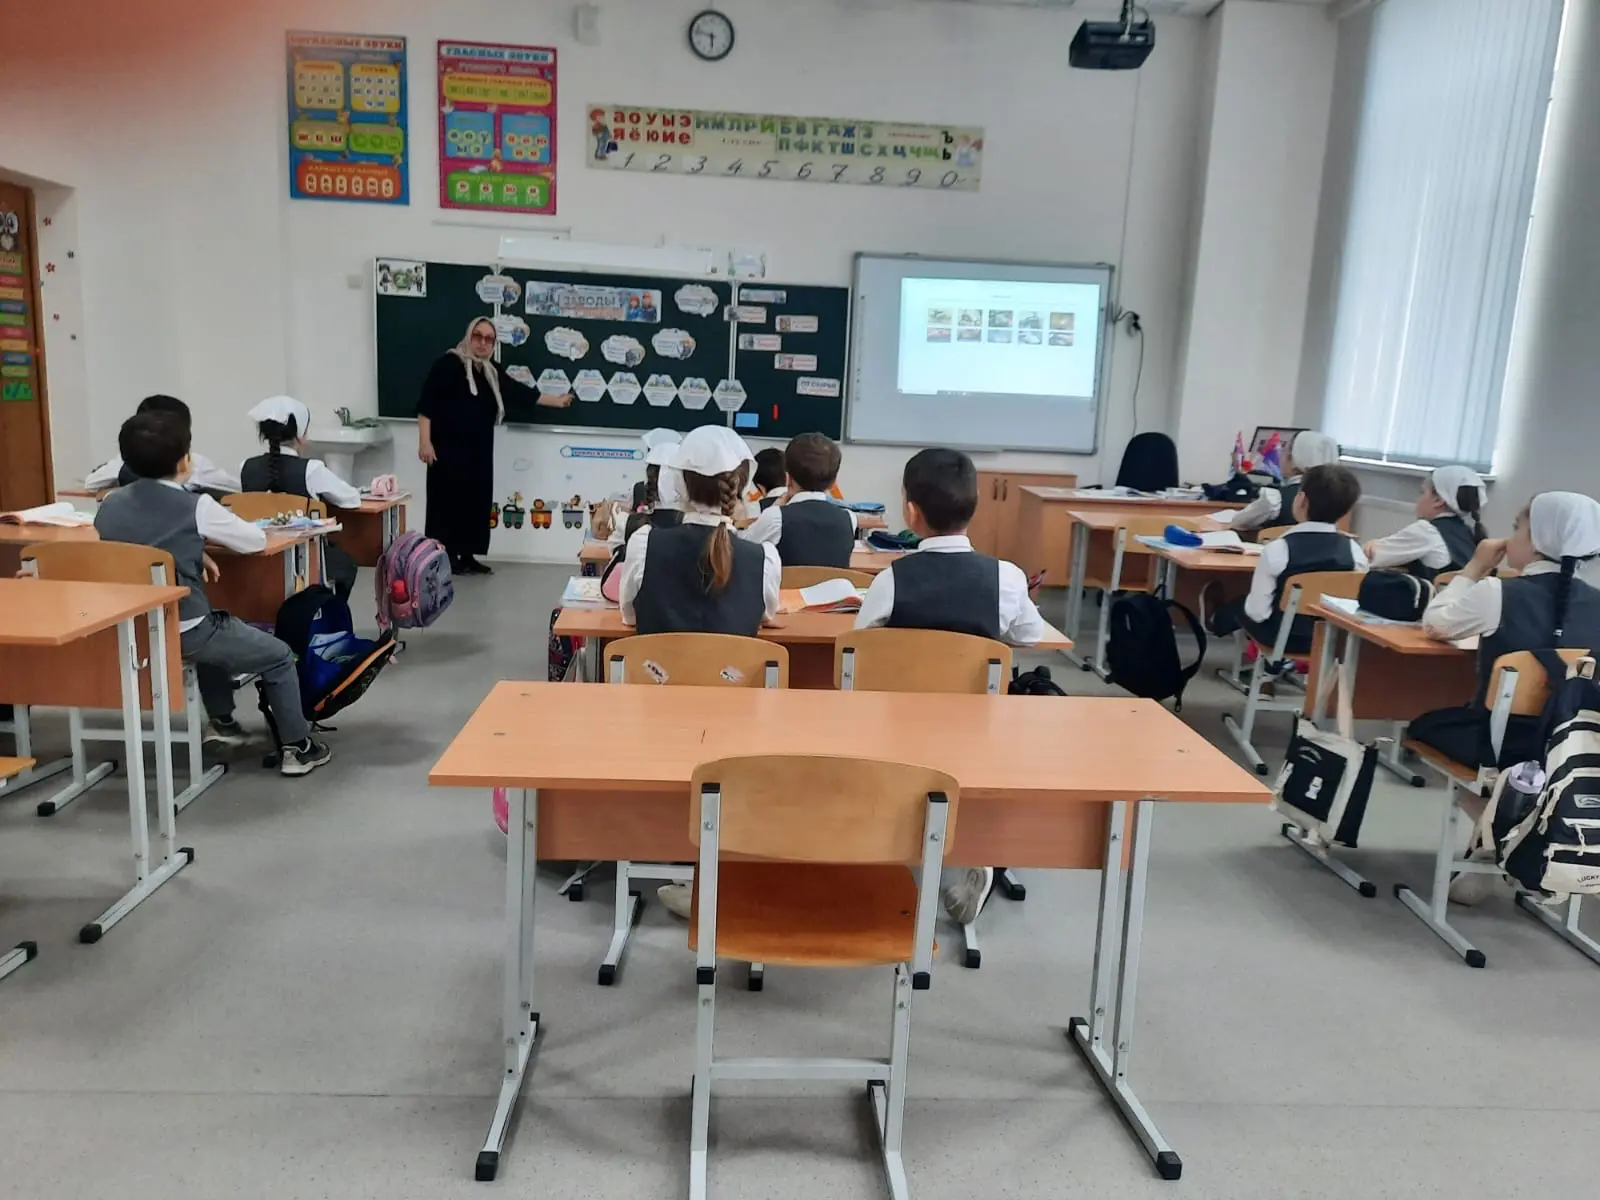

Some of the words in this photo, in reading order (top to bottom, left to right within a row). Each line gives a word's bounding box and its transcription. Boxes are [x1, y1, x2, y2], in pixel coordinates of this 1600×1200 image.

[652, 153, 672, 171] 2
[691, 155, 708, 172] 3
[758, 160, 780, 177] 5
[797, 162, 813, 180] 6
[832, 164, 848, 182] 7
[869, 166, 886, 184] 8
[905, 168, 922, 186] 9
